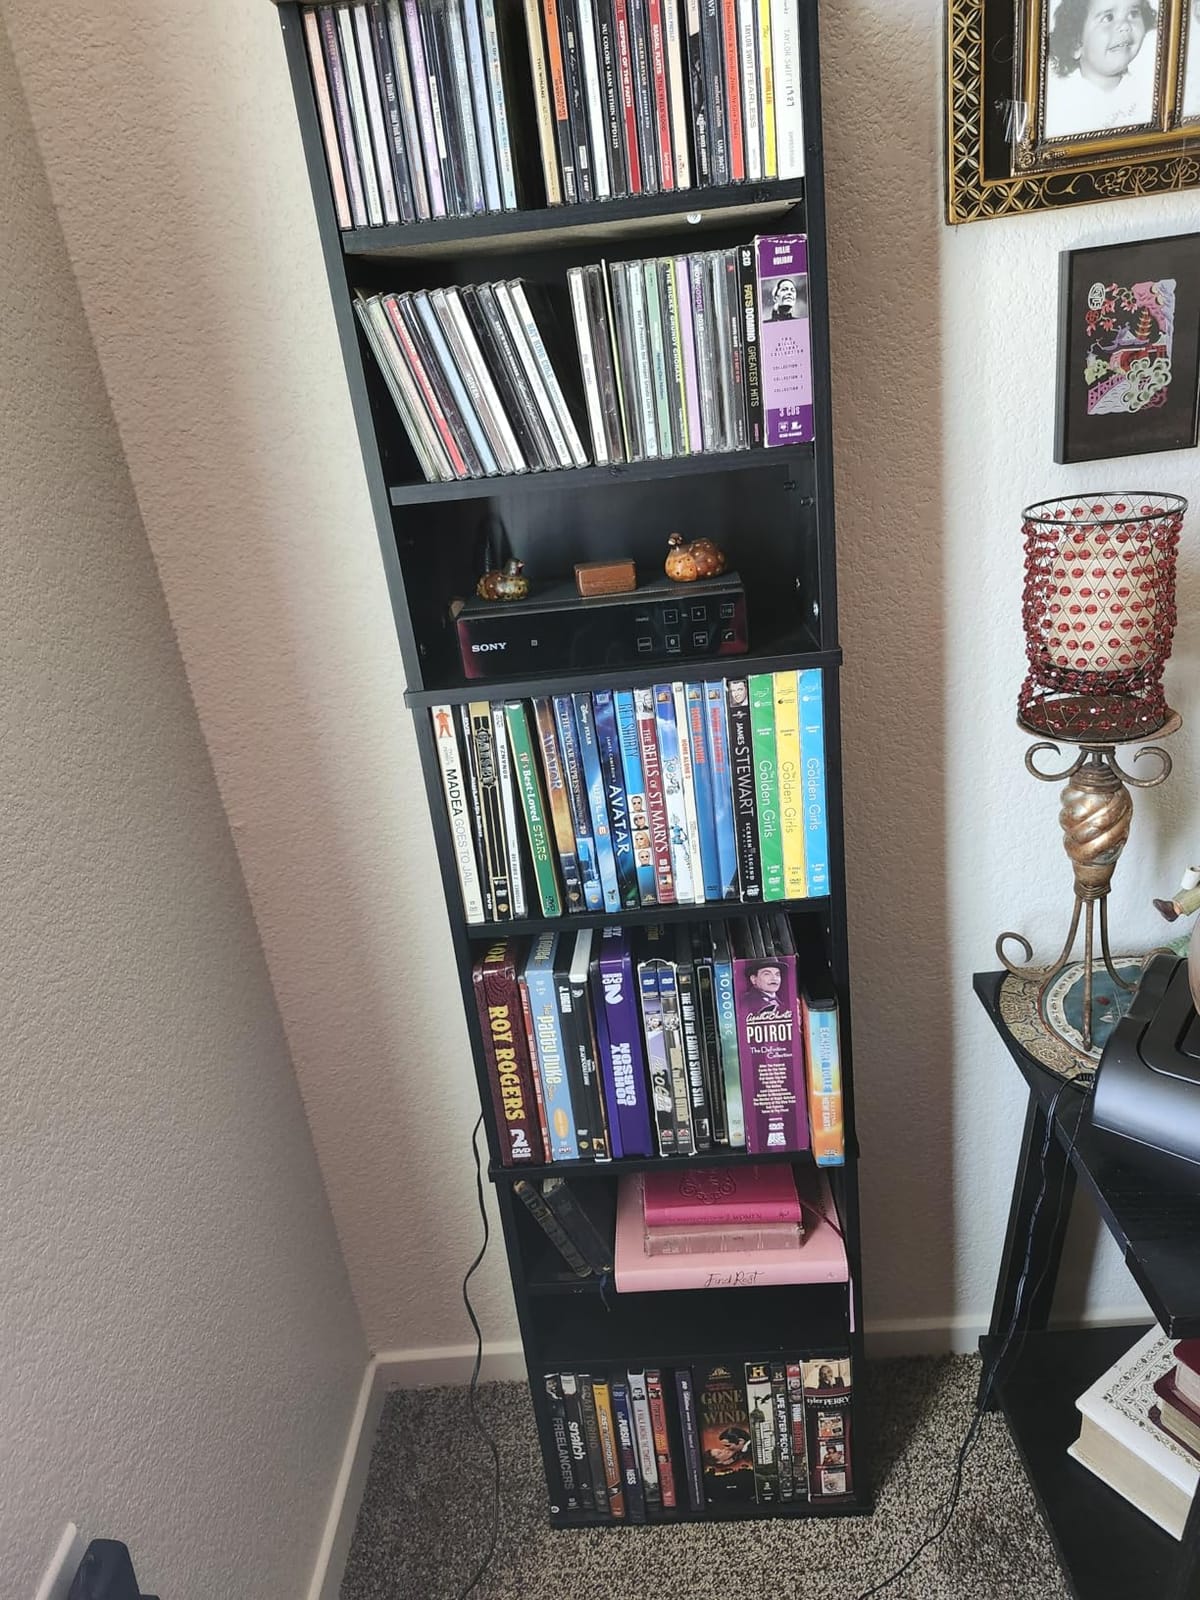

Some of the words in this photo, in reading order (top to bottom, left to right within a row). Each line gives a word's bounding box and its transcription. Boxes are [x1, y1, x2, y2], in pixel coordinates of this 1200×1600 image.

[601, 23, 608, 34] NU
[618, 20, 626, 55] KEEPERS
[652, 24, 660, 50] RASCAL
[743, 24, 751, 47] TAYLOR
[783, 28, 791, 56] TAYLOR
[602, 36, 611, 64] COLORS
[621, 57, 627, 67] OF
[654, 51, 662, 73] FLATTS
[745, 49, 753, 69] SWIFT
[784, 58, 792, 83] SWIFT
[607, 88, 616, 115] WITHIN
[713, 75, 721, 103] members
[746, 72, 756, 128] FEARLESS
[715, 105, 723, 127] edition
[744, 284, 753, 307] FATS
[666, 284, 674, 313] RICKEY
[672, 347, 680, 382] CHORALE
[745, 307, 755, 342] DOMINO
[533, 339, 545, 359] KING
[540, 359, 553, 379] COLE
[747, 345, 757, 386] GREATEST
[750, 388, 758, 406] HITS
[472, 642, 507, 653] SONY
[560, 711, 570, 729] THE
[579, 703, 590, 722] Disney
[618, 703, 633, 721] GET
[691, 706, 702, 733] HOME
[710, 707, 721, 733] HOME
[563, 731, 575, 758] POLAR
[621, 722, 638, 757] SHORTY
[643, 729, 652, 743] THE
[736, 722, 744, 745] JAMES
[499, 744, 508, 778] BONANZA
[541, 734, 562, 790] AVIATOR
[644, 744, 658, 776] BELLS
[693, 734, 705, 763] ALONE
[713, 736, 724, 764] ALONE
[568, 759, 581, 794] EXPRESS
[735, 745, 753, 817] STEWART
[758, 759, 774, 805] Golden
[781, 761, 795, 802] Golden
[807, 757, 820, 800] Golden
[445, 767, 463, 816] MADEA
[649, 791, 662, 807] ST.
[606, 783, 631, 855] AVATAR
[762, 809, 776, 837] Girls
[784, 807, 797, 833] Girls
[808, 804, 821, 830] Girls
[453, 817, 468, 850] GOES
[532, 824, 547, 861] STARS
[651, 809, 668, 853] MARY'S
[459, 849, 470, 863] TO
[462, 867, 474, 886] JAIL
[542, 1003, 553, 1015] The
[559, 991, 571, 1013] EDGAR
[605, 986, 623, 1005] 2
[680, 991, 691, 1004] THE
[717, 972, 732, 1019] 10,000
[487, 1004, 513, 1044] ROY
[681, 1004, 695, 1021] DAY
[536, 1014, 559, 1053] Patty
[684, 1022, 694, 1034] THE
[747, 1023, 792, 1044] POIROT
[685, 1034, 700, 1060] EARTH
[542, 1053, 563, 1084] Duke
[610, 1043, 626, 1106] JOHNNY
[619, 1042, 636, 1106] CARSON
[688, 1060, 702, 1086] STOOD
[495, 1046, 525, 1121] ROGERS
[691, 1087, 705, 1107] STILL
[510, 1129, 529, 1147] 2
[705, 1272, 732, 1288] Find
[734, 1271, 765, 1287] Rest
[580, 1384, 594, 1411] GRAN
[702, 1390, 743, 1405] GONE
[776, 1393, 785, 1408] LIFE
[703, 1411, 746, 1424] WIND
[777, 1409, 787, 1432] AFTER
[791, 1403, 801, 1421] FOUR
[567, 1419, 586, 1460] snatch
[585, 1414, 599, 1449] TORINO
[619, 1418, 630, 1446] PURSUIT
[549, 1416, 577, 1490] FREELANCERS
[778, 1433, 790, 1460] PEOPLE
